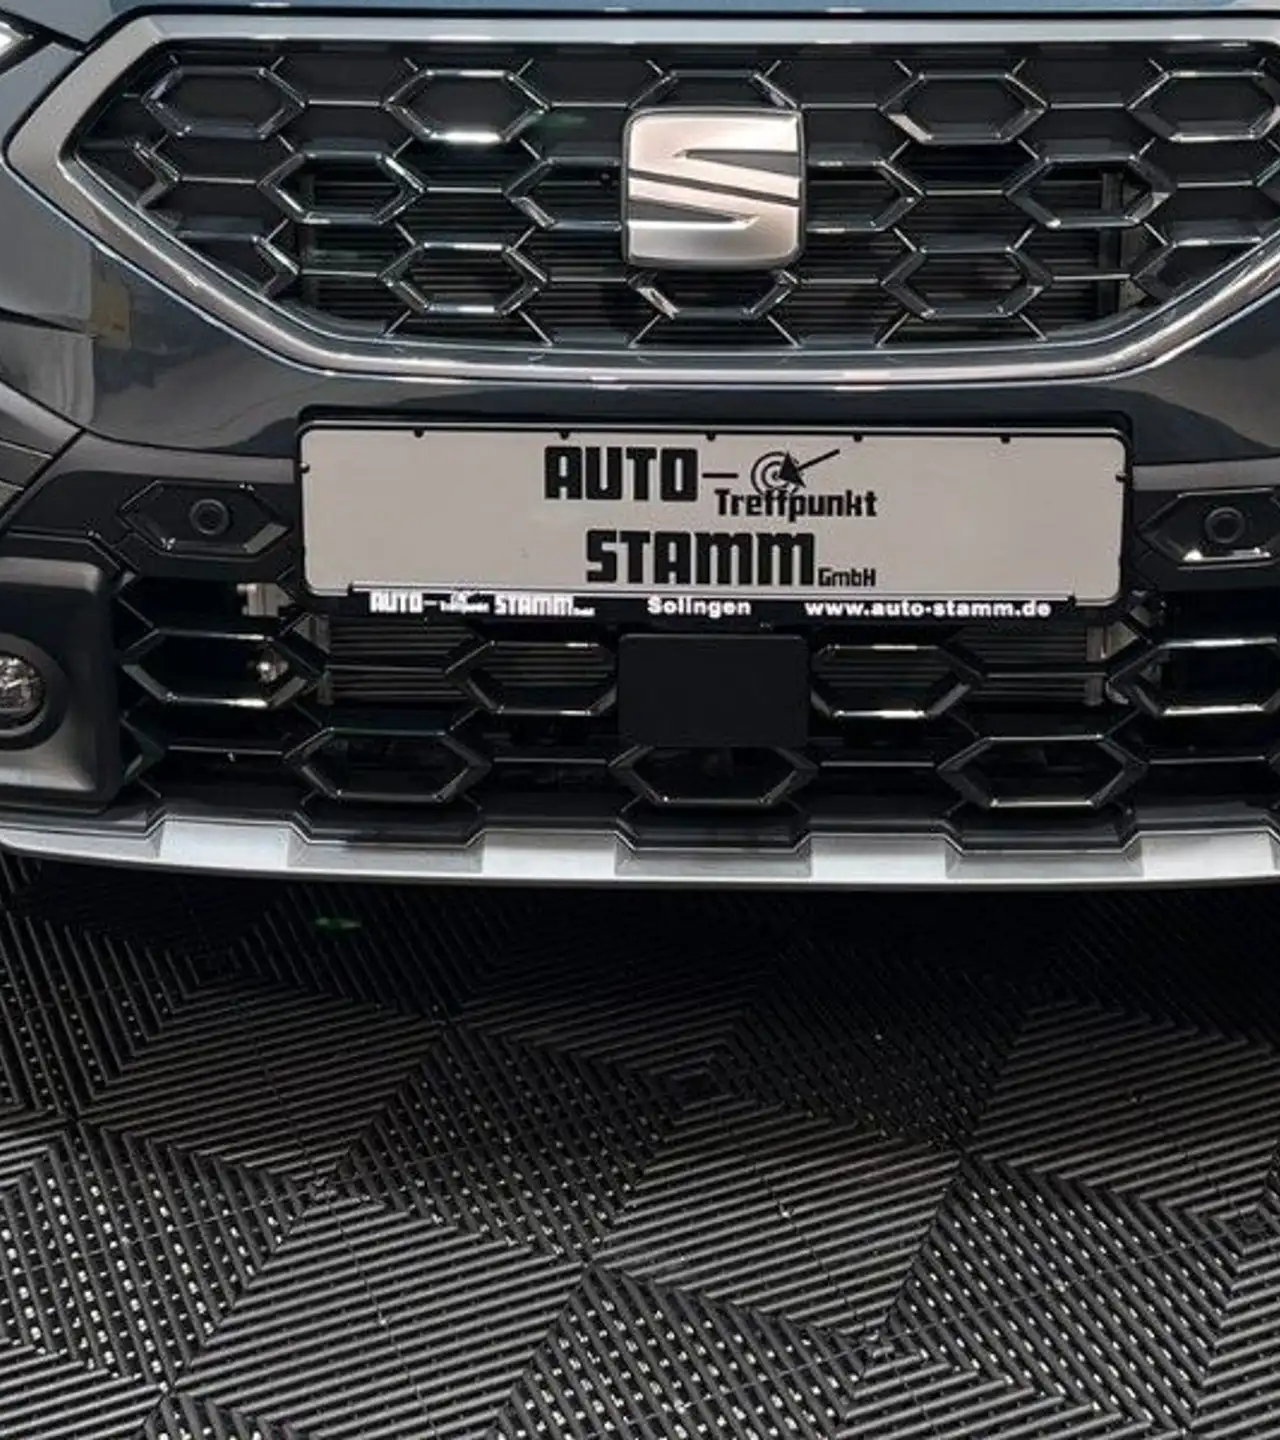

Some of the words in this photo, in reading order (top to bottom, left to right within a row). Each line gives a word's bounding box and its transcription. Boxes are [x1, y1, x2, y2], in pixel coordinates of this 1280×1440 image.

[715, 489, 877, 522] Treffpunkt
[586, 529, 815, 586] STAMM
[818, 568, 876, 587] GmbH
[646, 594, 752, 619] Solingen
[805, 598, 1052, 618] www.auto-stamm.de
